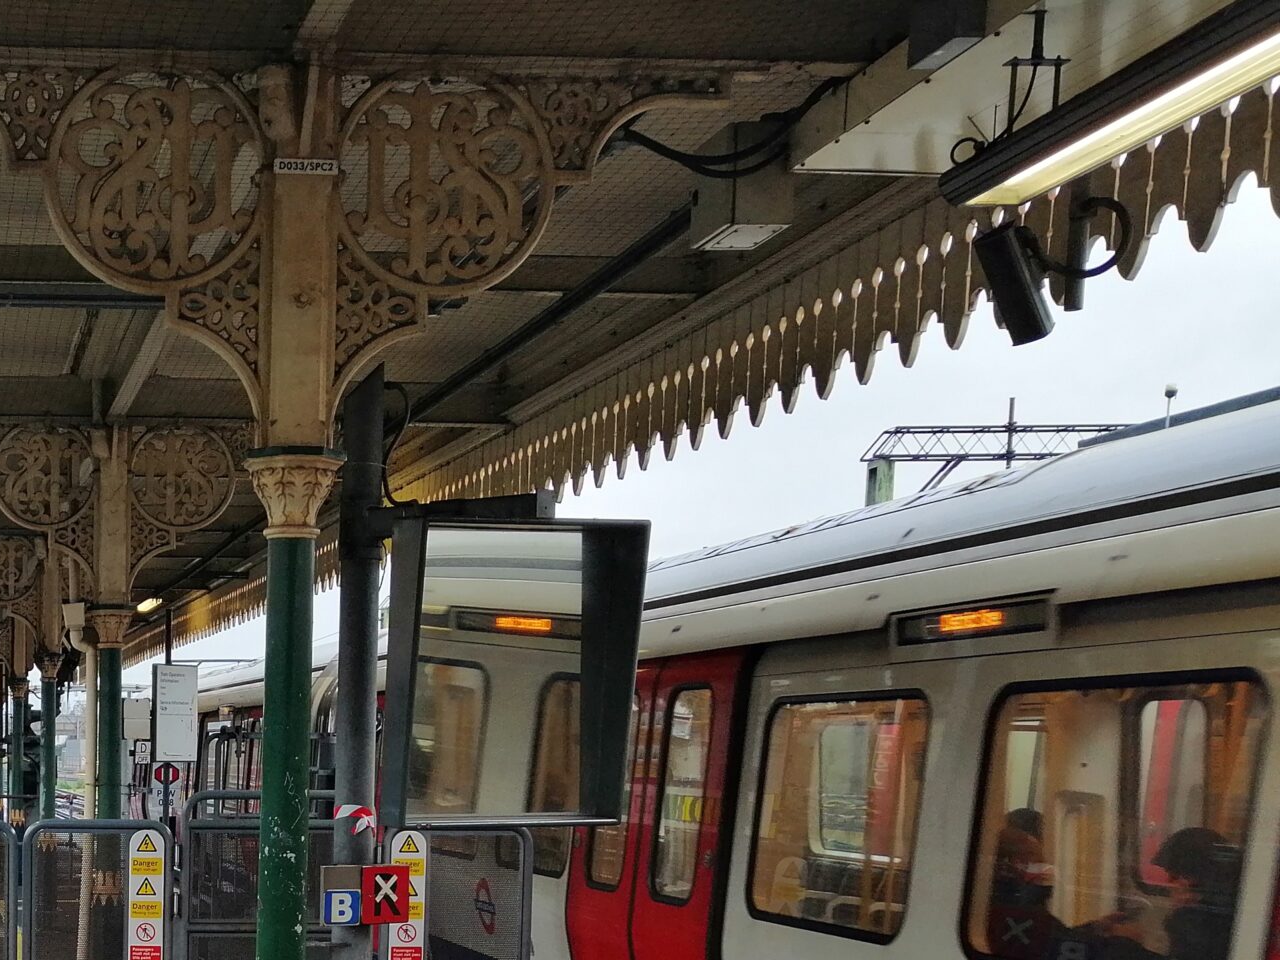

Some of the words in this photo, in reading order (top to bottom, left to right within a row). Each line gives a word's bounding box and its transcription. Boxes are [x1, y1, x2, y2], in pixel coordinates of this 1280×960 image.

[278, 161, 334, 172] D033/SPC2
[140, 743, 147, 753] D
[132, 859, 159, 868] Danger
[132, 903, 158, 911] Danger
[330, 892, 353, 923] B
